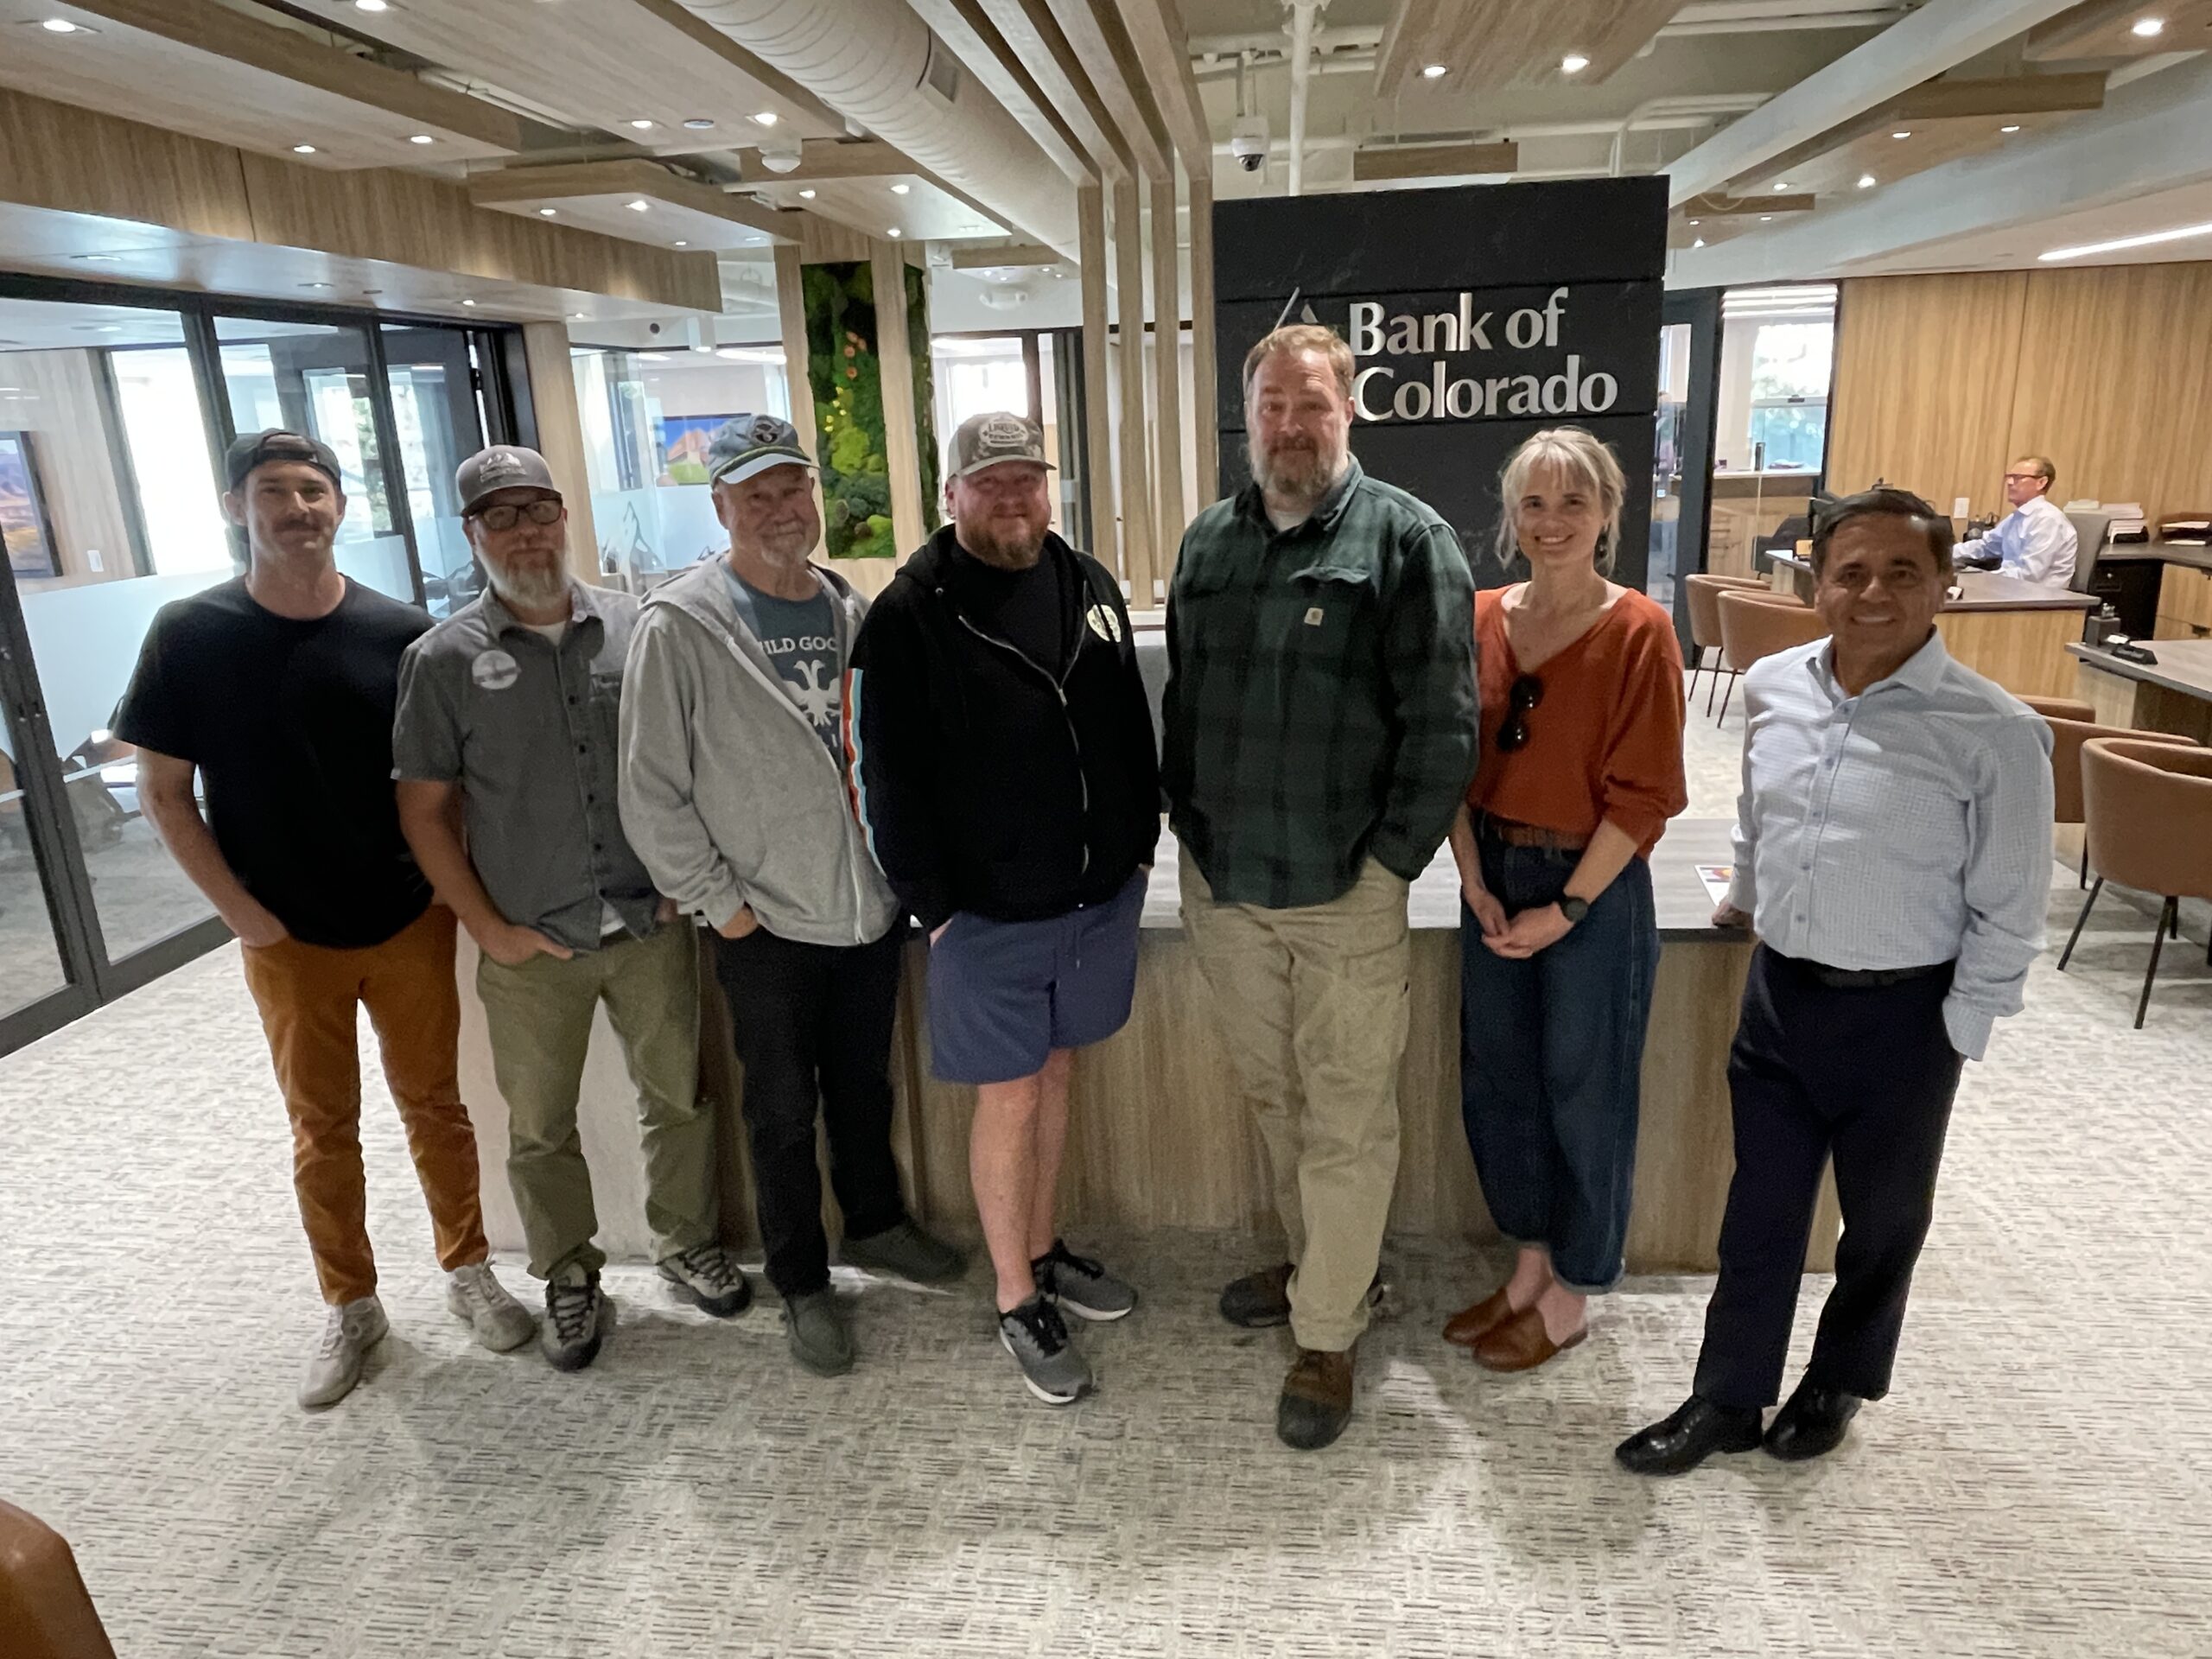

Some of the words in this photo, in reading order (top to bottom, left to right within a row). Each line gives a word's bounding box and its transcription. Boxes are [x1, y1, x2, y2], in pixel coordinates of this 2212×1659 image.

[1349, 292, 1494, 356] Bank
[1505, 287, 1569, 348] of
[1351, 354, 1618, 421] Colorado
[760, 638, 796, 654] ILD
